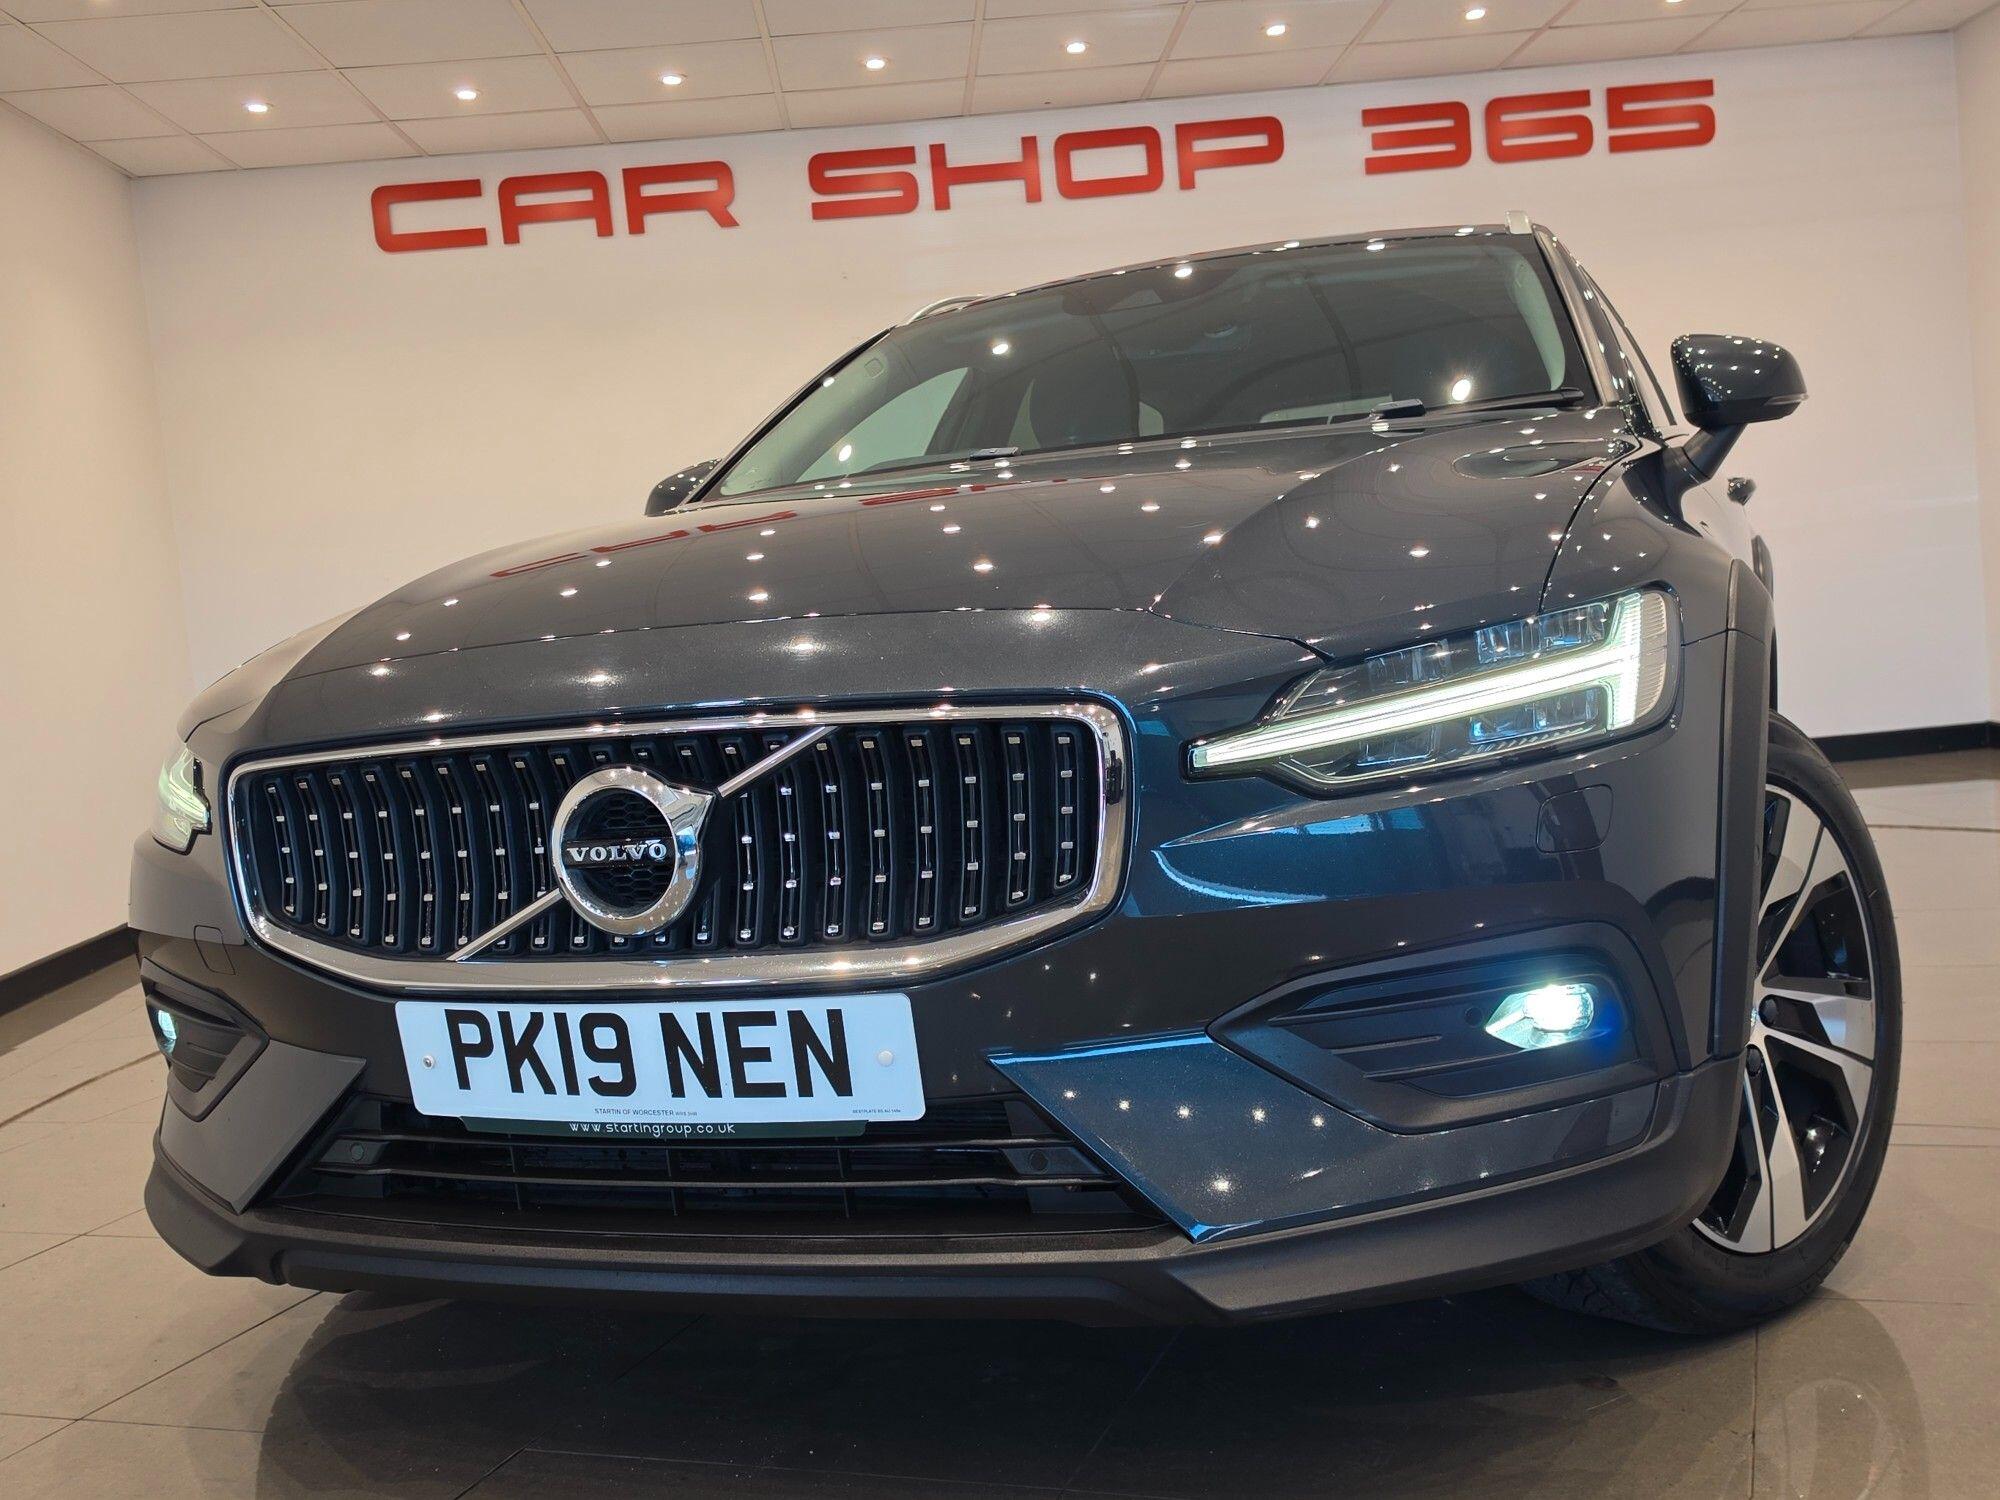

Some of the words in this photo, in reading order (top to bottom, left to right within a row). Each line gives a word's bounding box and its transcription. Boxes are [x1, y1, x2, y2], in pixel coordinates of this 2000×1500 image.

[371, 160, 740, 253] CAR
[808, 116, 1285, 220] SHOP
[1362, 79, 1716, 175] 365
[566, 841, 667, 862] VOLVO
[444, 1008, 638, 1098] PK19
[658, 1008, 854, 1099] NEN
[594, 1107, 622, 1116] STARTIN
[622, 1108, 631, 1116] OF
[632, 1108, 674, 1117] WORCESTER
